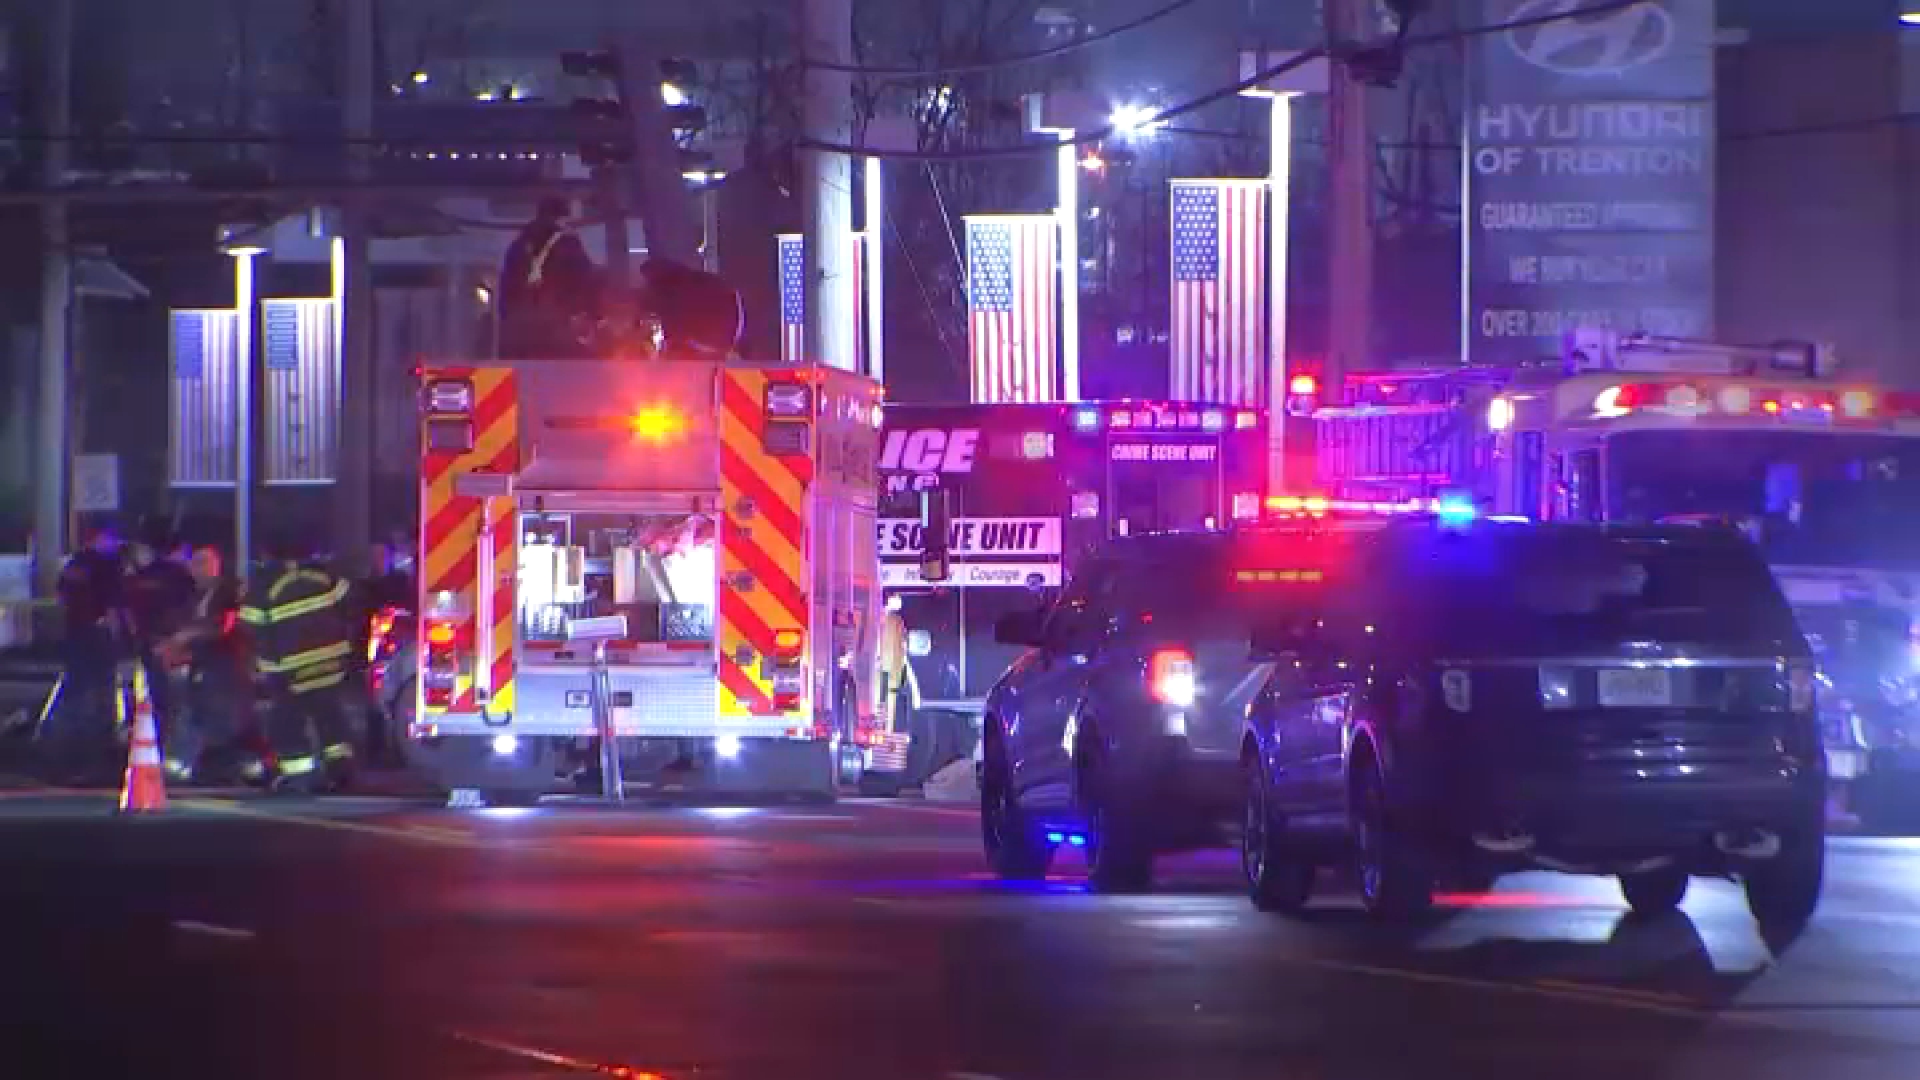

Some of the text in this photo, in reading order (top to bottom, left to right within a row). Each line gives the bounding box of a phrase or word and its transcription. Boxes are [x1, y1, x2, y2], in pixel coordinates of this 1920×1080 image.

[1479, 103, 1701, 138] HYUNDAI
[1475, 147, 1701, 175] OF TRENTON
[1482, 309, 1528, 337] OVER
[1151, 444, 1187, 461] SCENE
[1188, 445, 1217, 461] UNIT
[980, 522, 1045, 550] UNIT
[970, 567, 1020, 583] Courage
